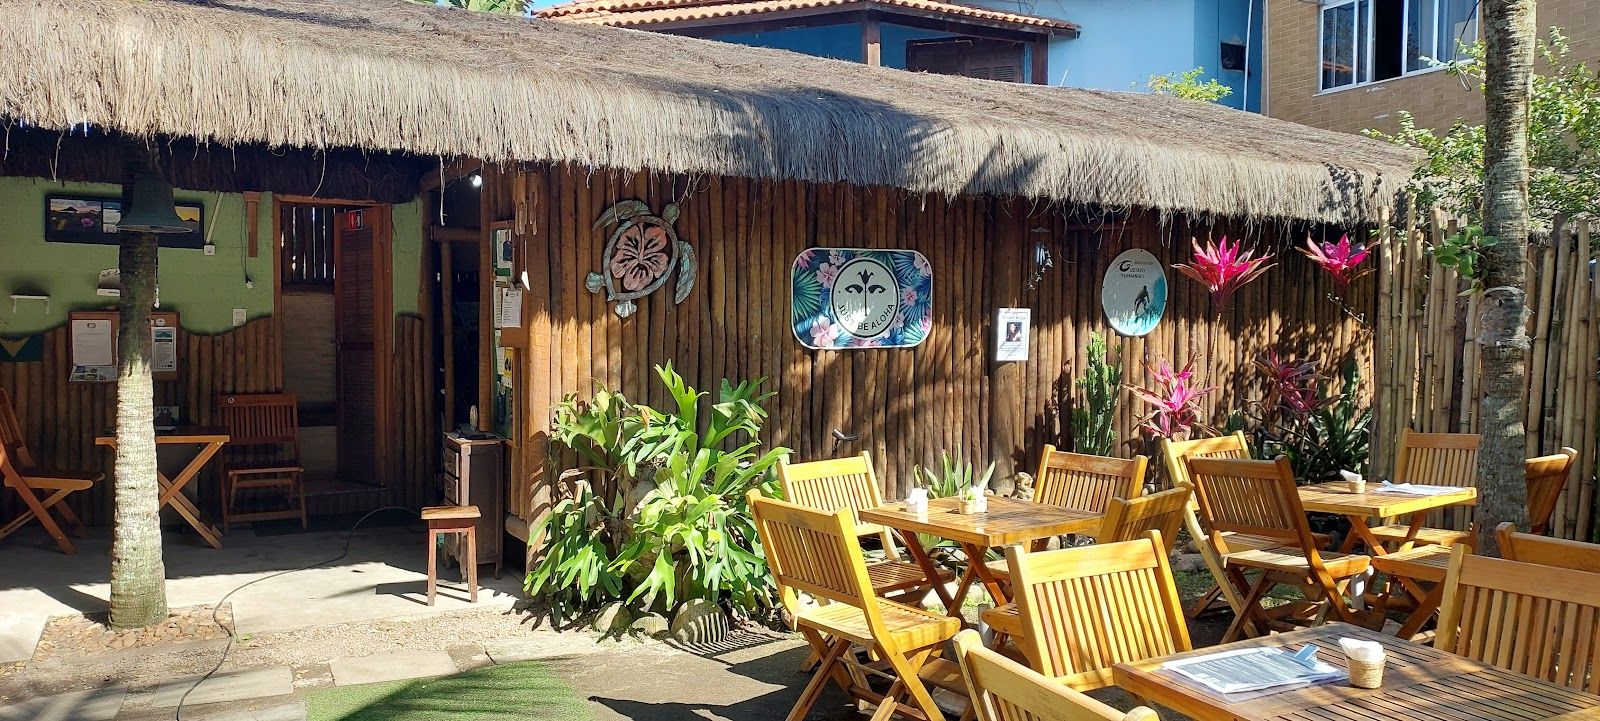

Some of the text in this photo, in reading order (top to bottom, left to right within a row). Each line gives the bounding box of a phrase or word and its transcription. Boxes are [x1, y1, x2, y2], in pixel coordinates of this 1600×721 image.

[838, 304, 895, 331] JUST BE ALOHA
